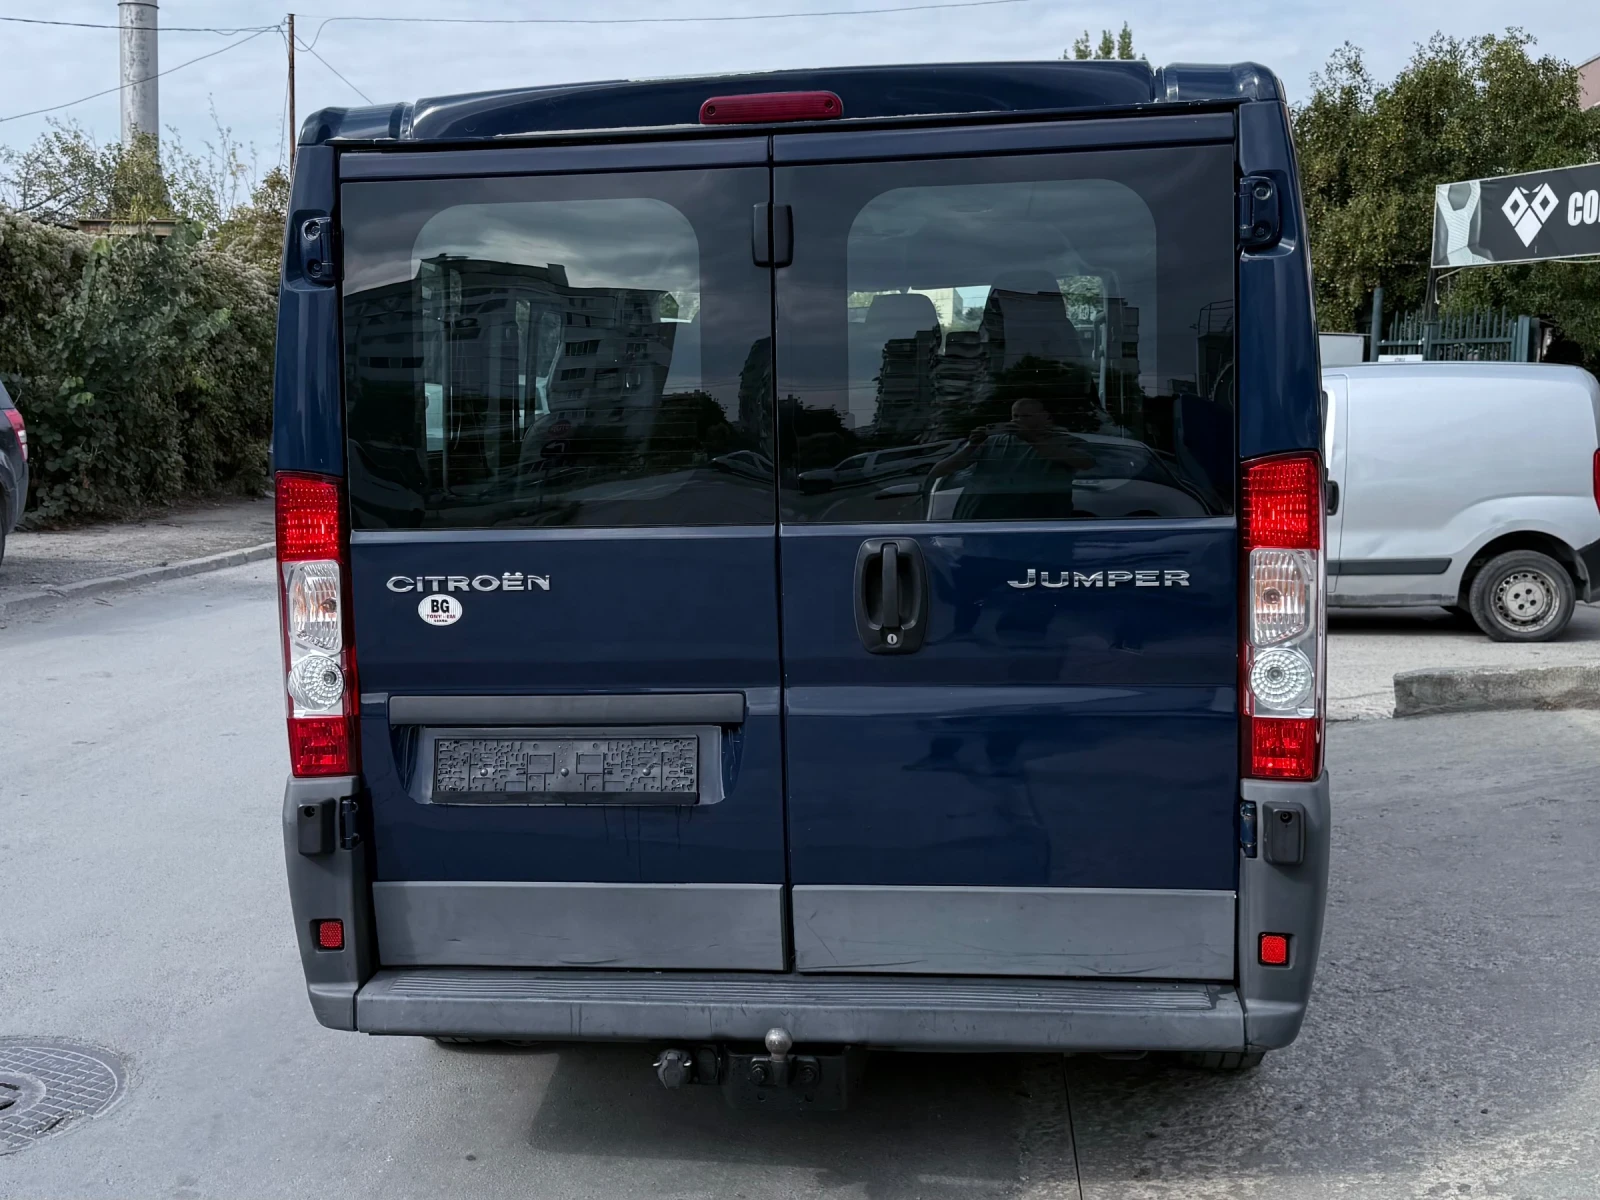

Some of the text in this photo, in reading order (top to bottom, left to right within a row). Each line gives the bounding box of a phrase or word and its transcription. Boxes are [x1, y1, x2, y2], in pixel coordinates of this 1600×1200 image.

[1567, 189, 1600, 226] CO
[386, 571, 550, 593] CITROËN
[1007, 568, 1190, 589] JUMPER
[430, 599, 450, 614] BG
